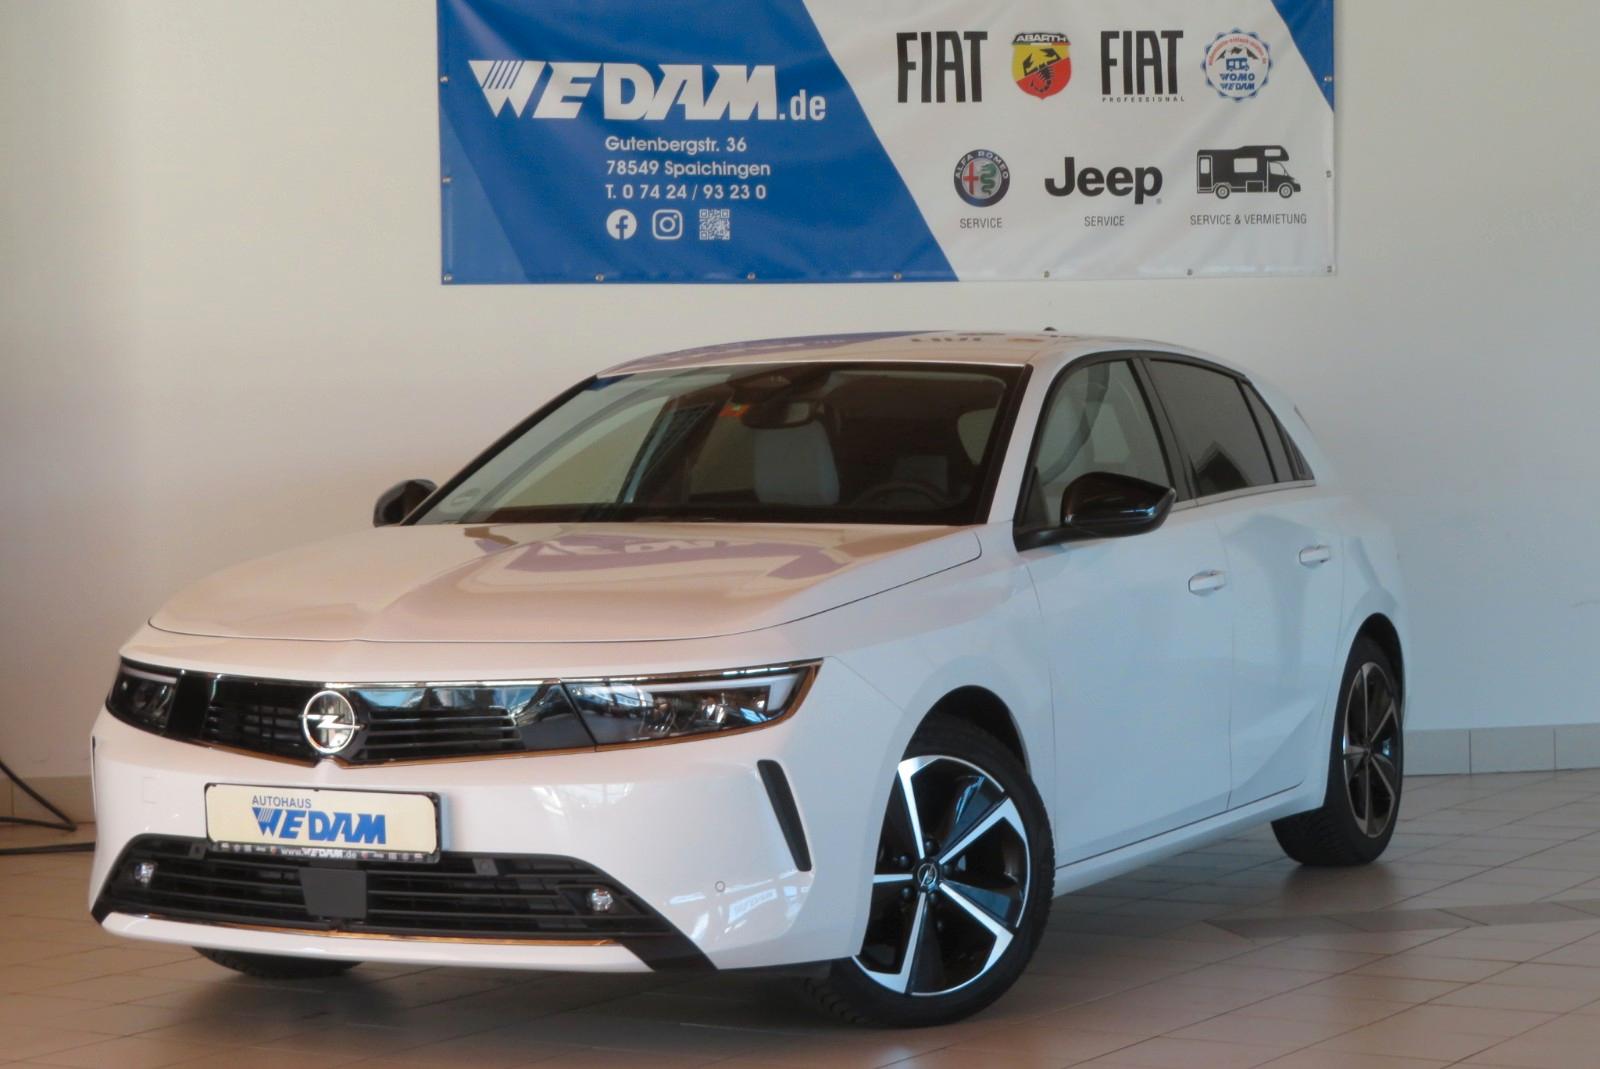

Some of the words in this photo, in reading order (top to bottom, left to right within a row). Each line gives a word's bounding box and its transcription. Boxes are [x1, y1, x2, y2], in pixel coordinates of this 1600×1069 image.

[1016, 34, 1066, 42] ABARTH
[896, 31, 988, 104] FIAT
[1100, 30, 1184, 96] FIAT
[1219, 73, 1256, 82] WOMO
[604, 135, 720, 155] Gutenbergstr.
[726, 136, 748, 153] 36
[606, 159, 660, 176] 78549
[664, 160, 771, 179] Spaichingen
[977, 150, 1009, 180] ROMEO
[1044, 156, 1163, 205] Jeep
[605, 183, 617, 199] T.
[622, 183, 634, 199] 0
[639, 184, 660, 199] 74
[666, 184, 687, 200] 24
[703, 184, 724, 200] 93
[730, 184, 750, 199] 23
[755, 184, 766, 199] 0
[959, 217, 1003, 230] SERVICE
[1084, 215, 1125, 227] SERVICE
[1189, 214, 1232, 227] SERVICE
[1234, 214, 1242, 225] &
[1244, 213, 1307, 226] VERMIETUNG
[252, 795, 312, 809] AUTOHAUS
[252, 807, 387, 845] WEDAM
